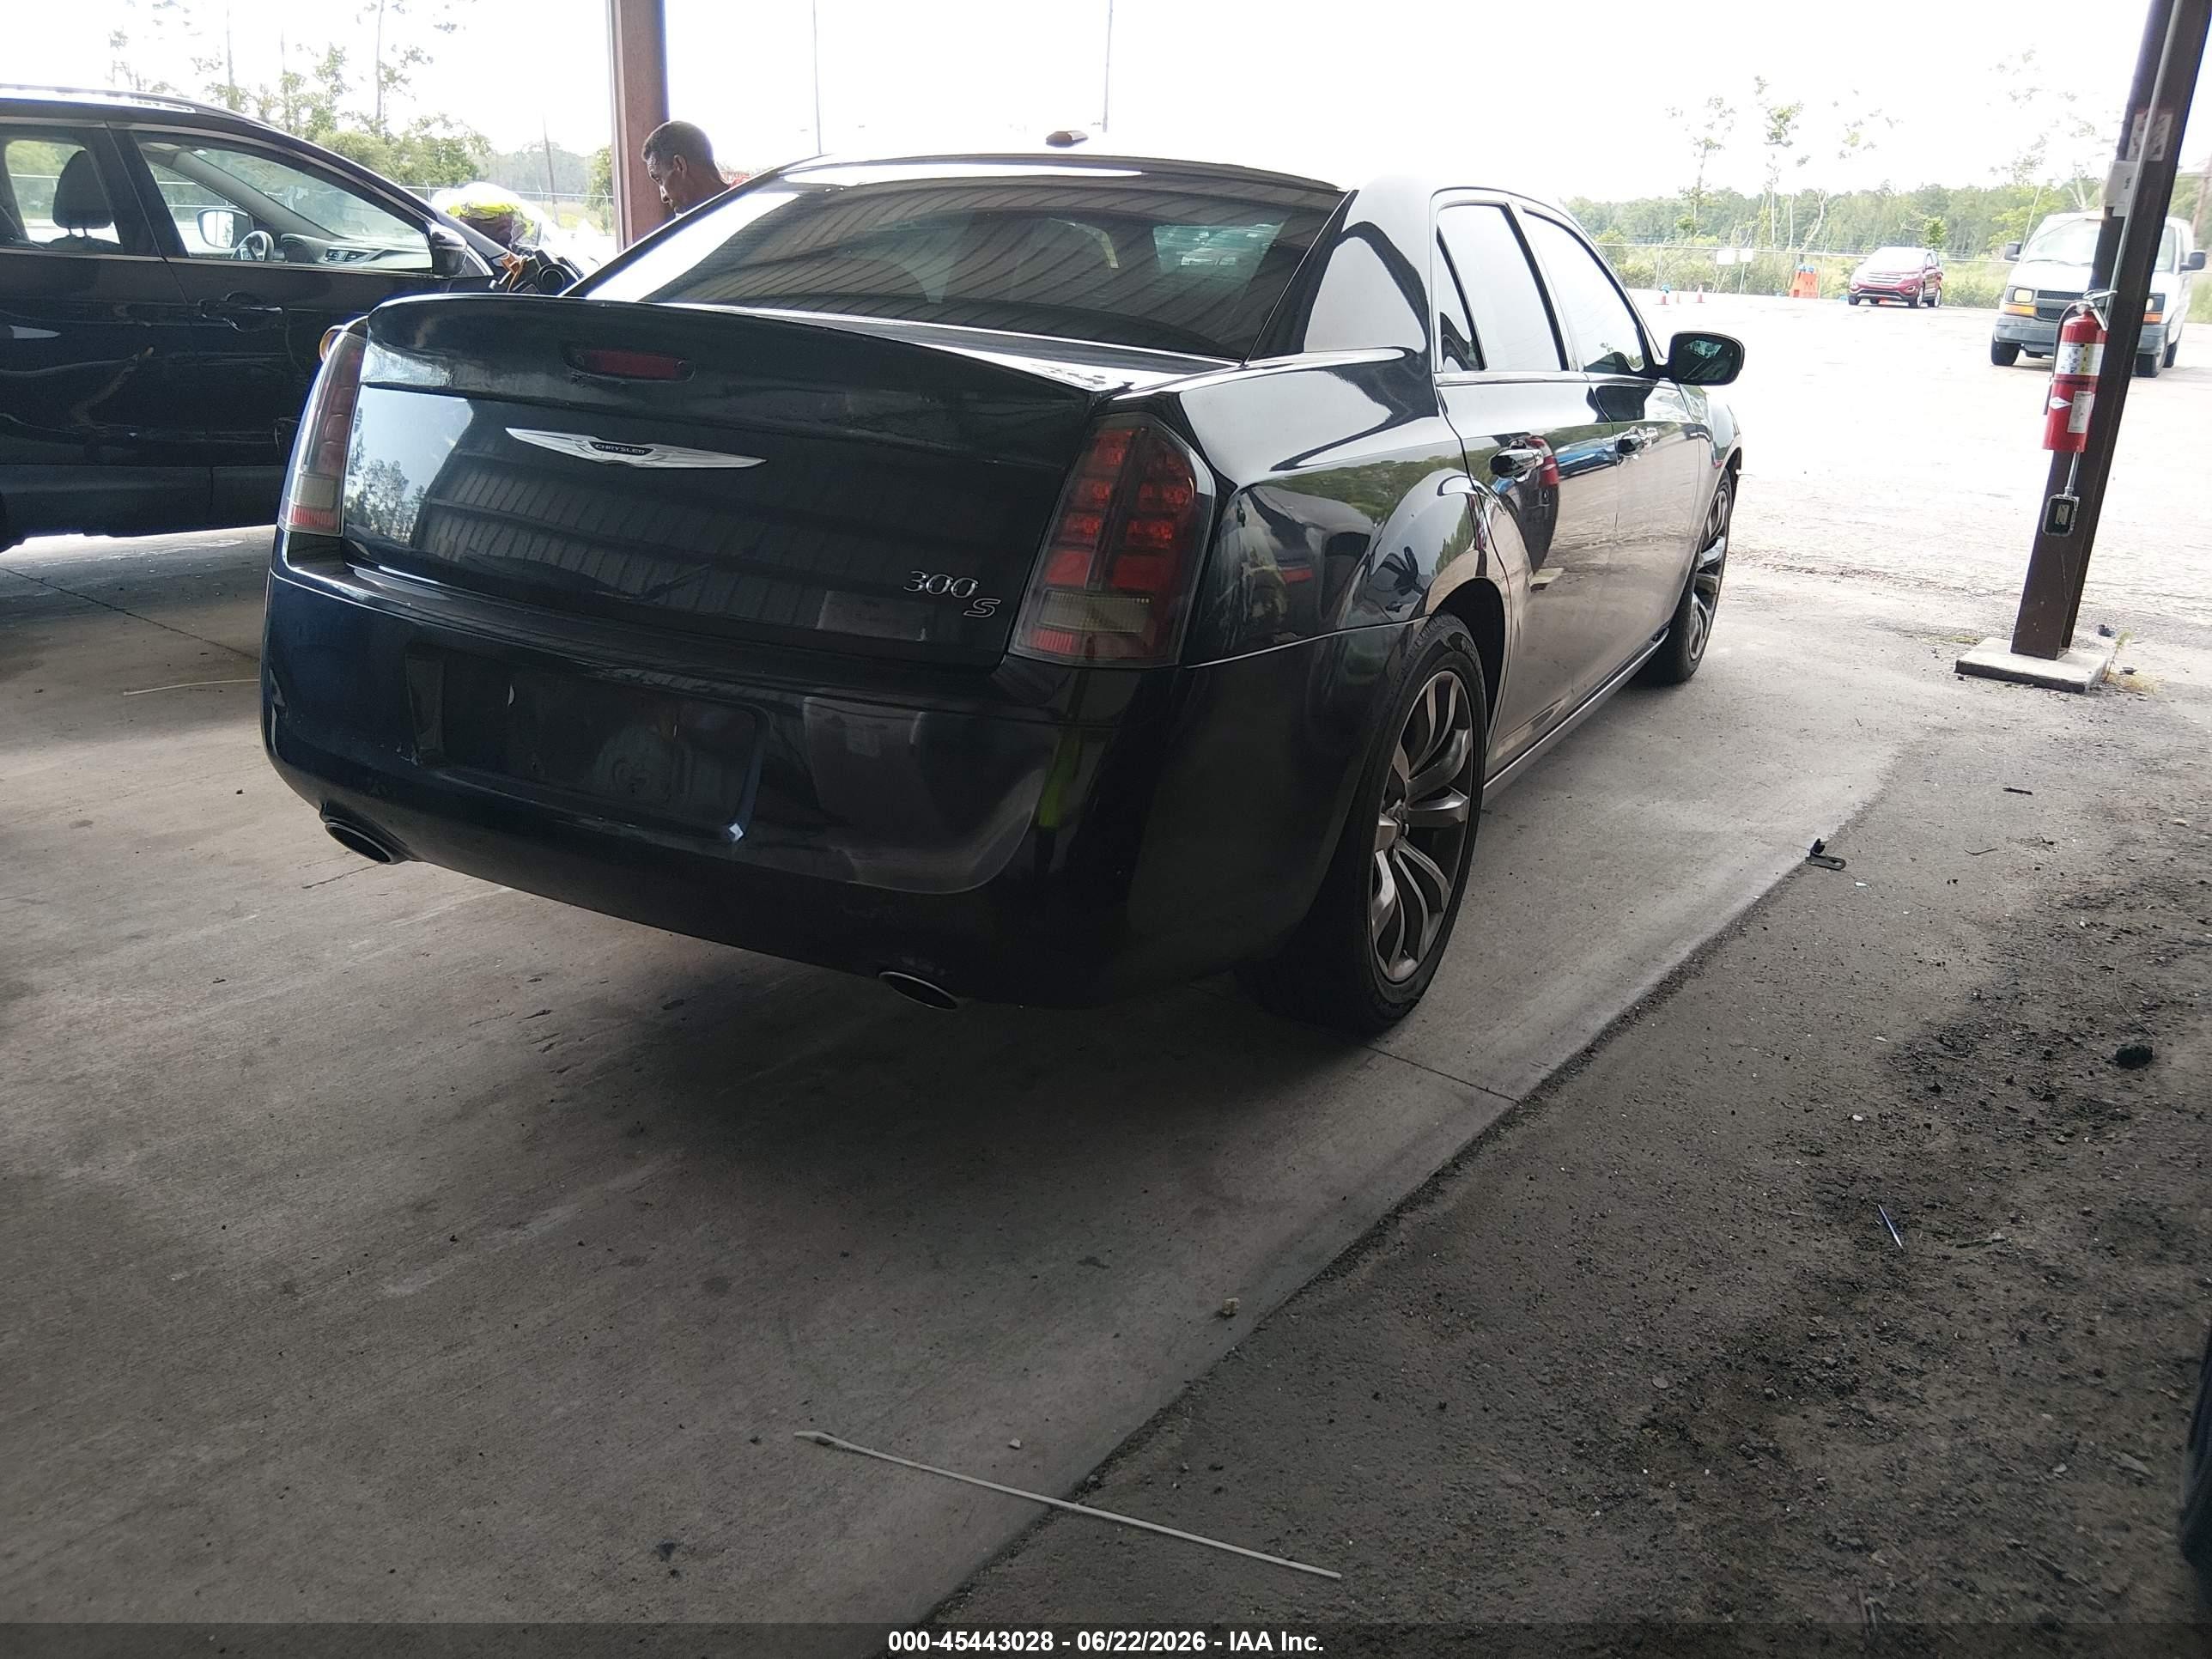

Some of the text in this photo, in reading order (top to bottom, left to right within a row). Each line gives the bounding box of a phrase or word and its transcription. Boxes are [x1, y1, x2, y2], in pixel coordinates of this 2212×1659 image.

[595, 444, 646, 454] CHRYSLER
[902, 570, 979, 599] 300
[963, 598, 1002, 618] S
